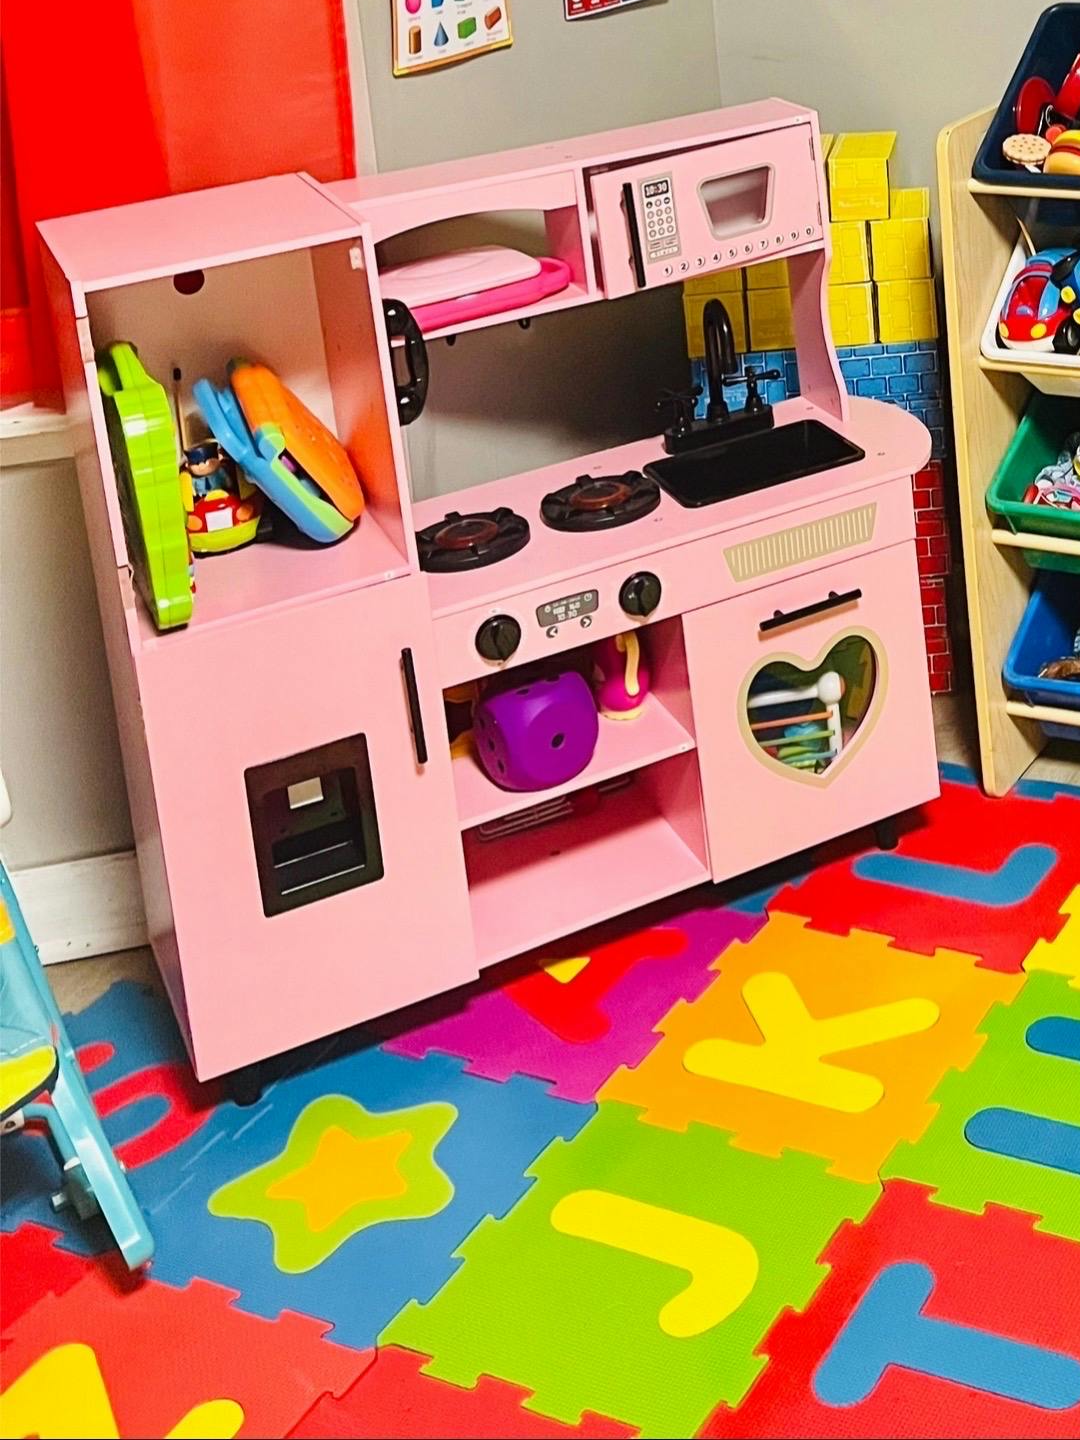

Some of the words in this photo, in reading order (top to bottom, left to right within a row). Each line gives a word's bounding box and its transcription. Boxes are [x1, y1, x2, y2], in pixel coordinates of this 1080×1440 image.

[852, 842, 1059, 907] L
[683, 971, 941, 1113] K
[549, 1188, 760, 1338] J
